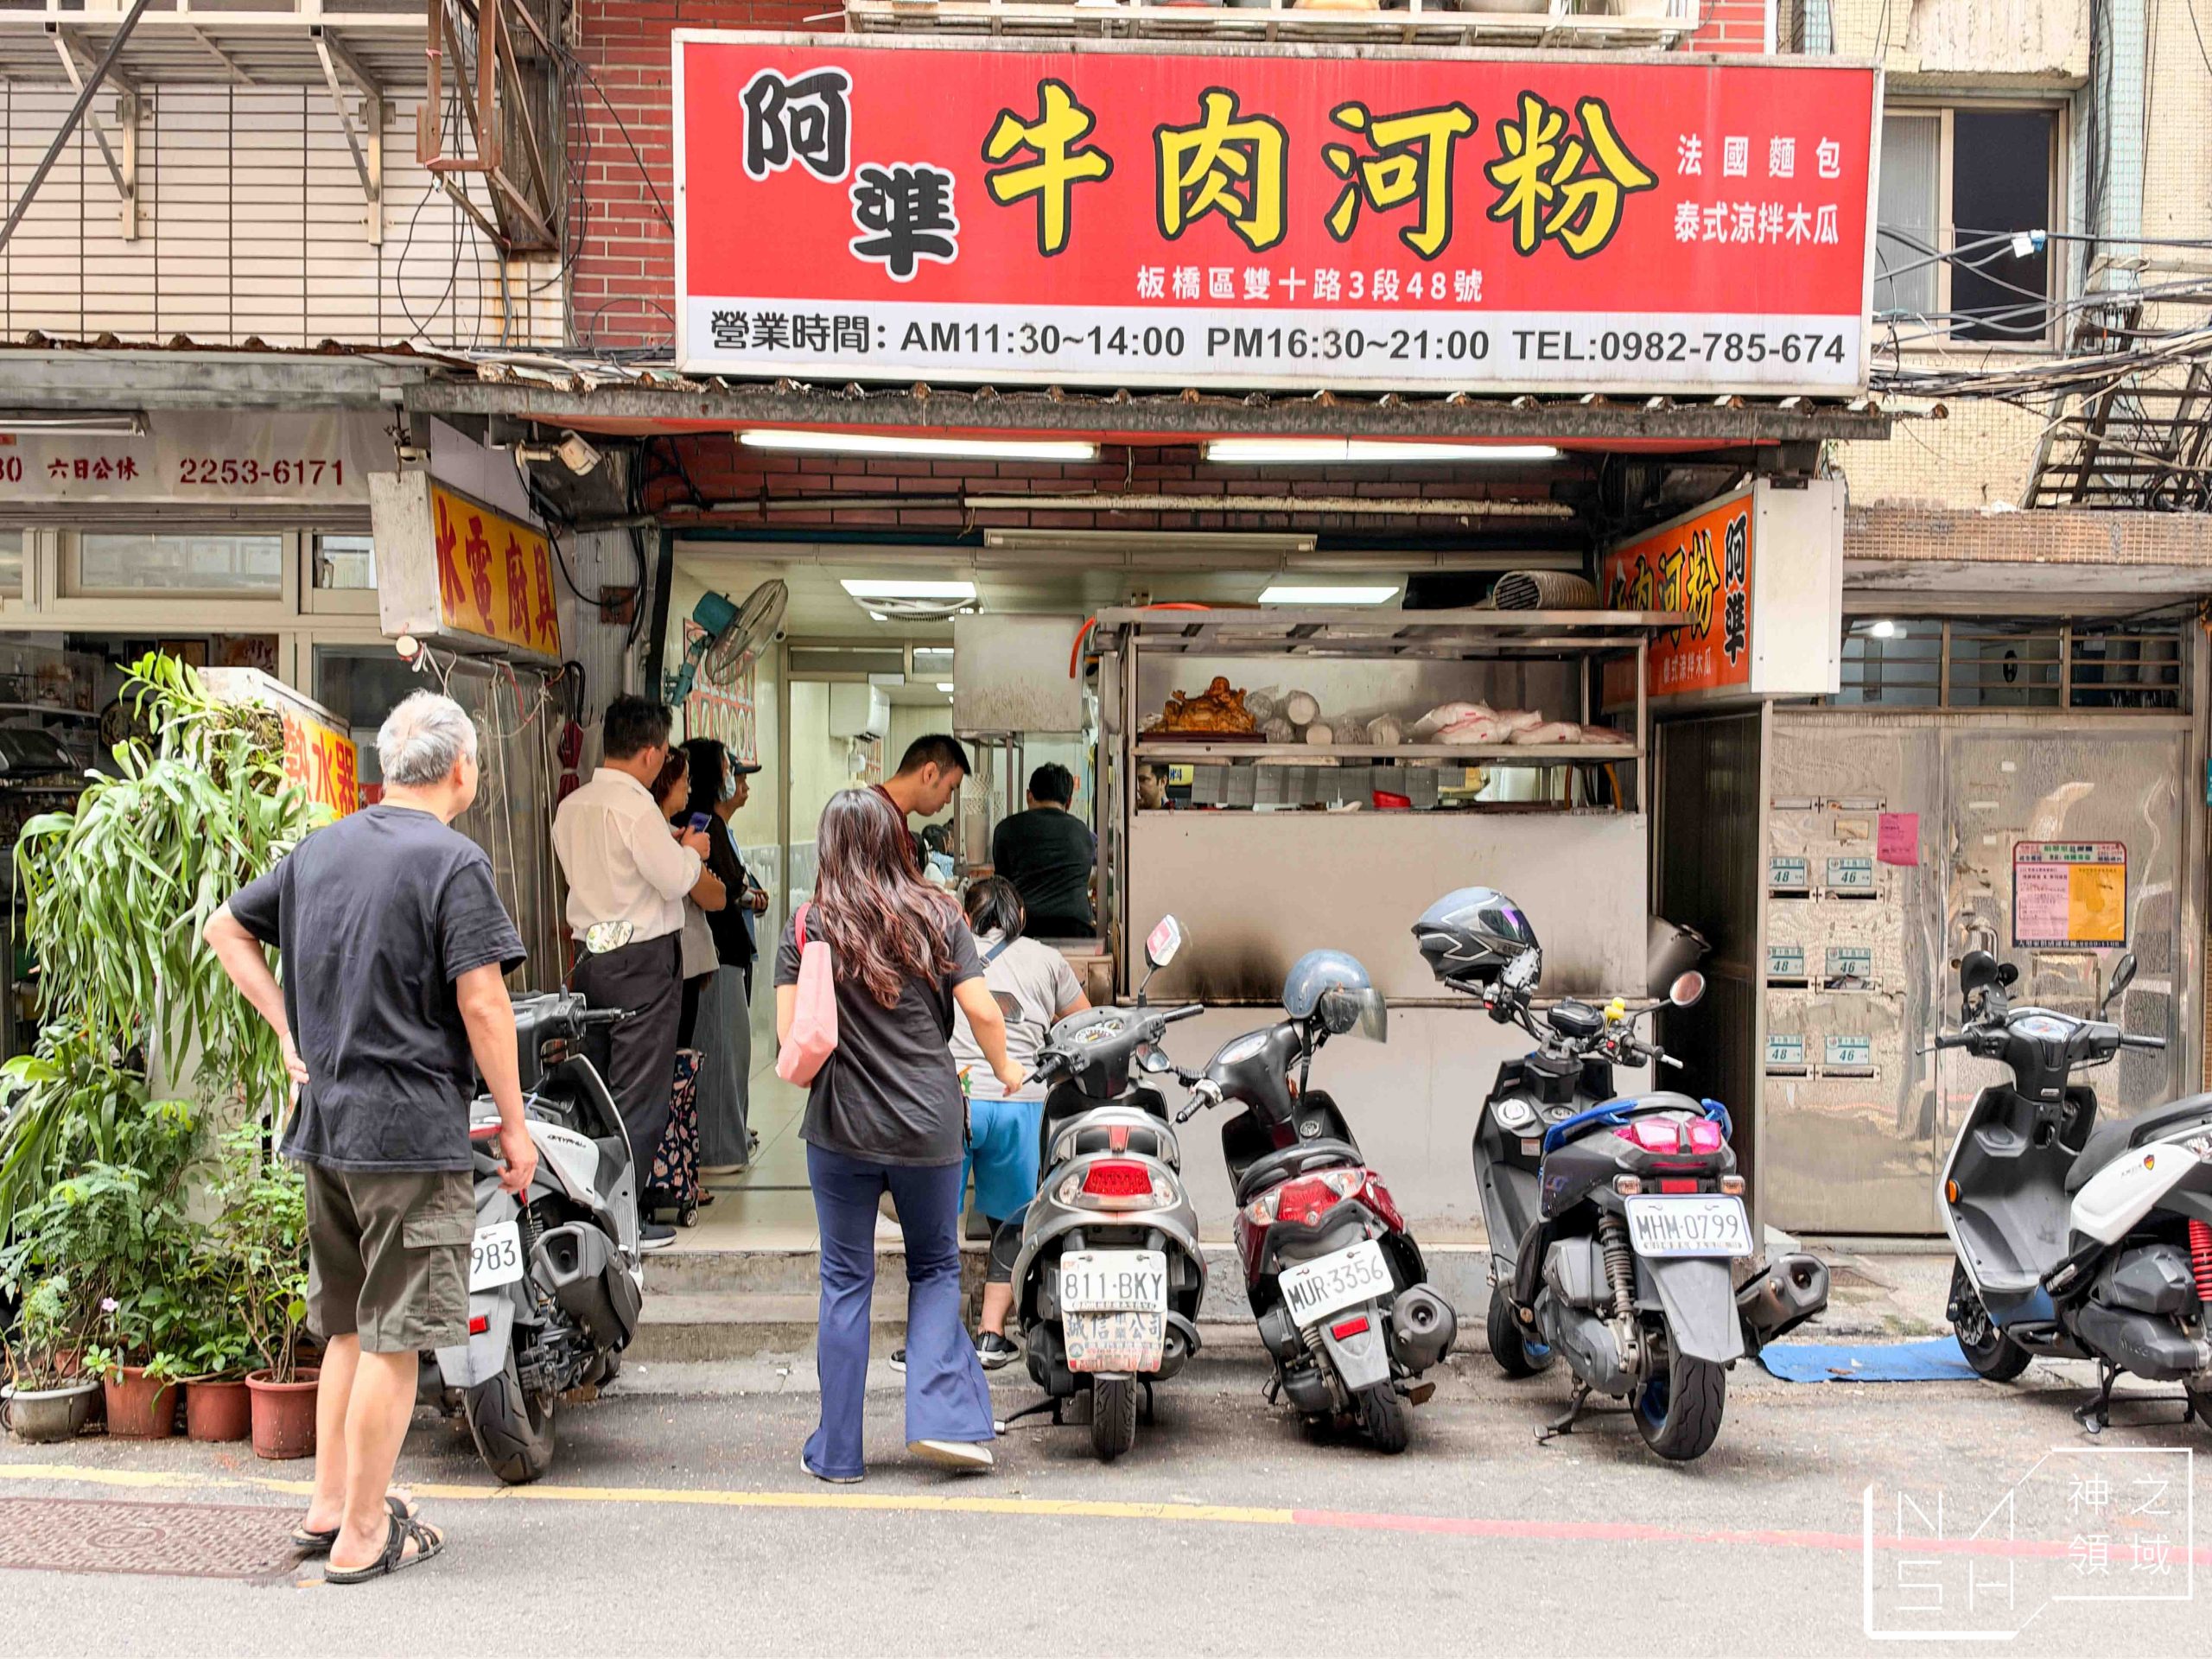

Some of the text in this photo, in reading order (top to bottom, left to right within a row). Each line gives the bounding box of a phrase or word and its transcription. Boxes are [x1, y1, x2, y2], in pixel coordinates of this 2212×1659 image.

[741, 68, 957, 281] 阿準
[982, 79, 1658, 260] 牛肉河粉
[1677, 134, 1840, 180] 法國麵包
[1675, 200, 1839, 245] 泰式涼拌木瓜
[1136, 264, 1483, 304] 板橋區雙十路3段48號
[900, 322, 1185, 358] AM11:30~14:00
[1207, 327, 1490, 360] PM16:30~21:00
[1512, 328, 1846, 364] TEL:0982-785-674
[48, 456, 139, 481] 六日公休
[180, 458, 343, 486] 2253-6171
[435, 495, 557, 652] 水電廚具
[1774, 871, 1789, 882] 48
[1841, 871, 1856, 883] 46
[1773, 961, 1789, 972] 48
[1840, 962, 1855, 973] 46
[1771, 1048, 1787, 1059] 48
[1839, 1050, 1854, 1061] 46
